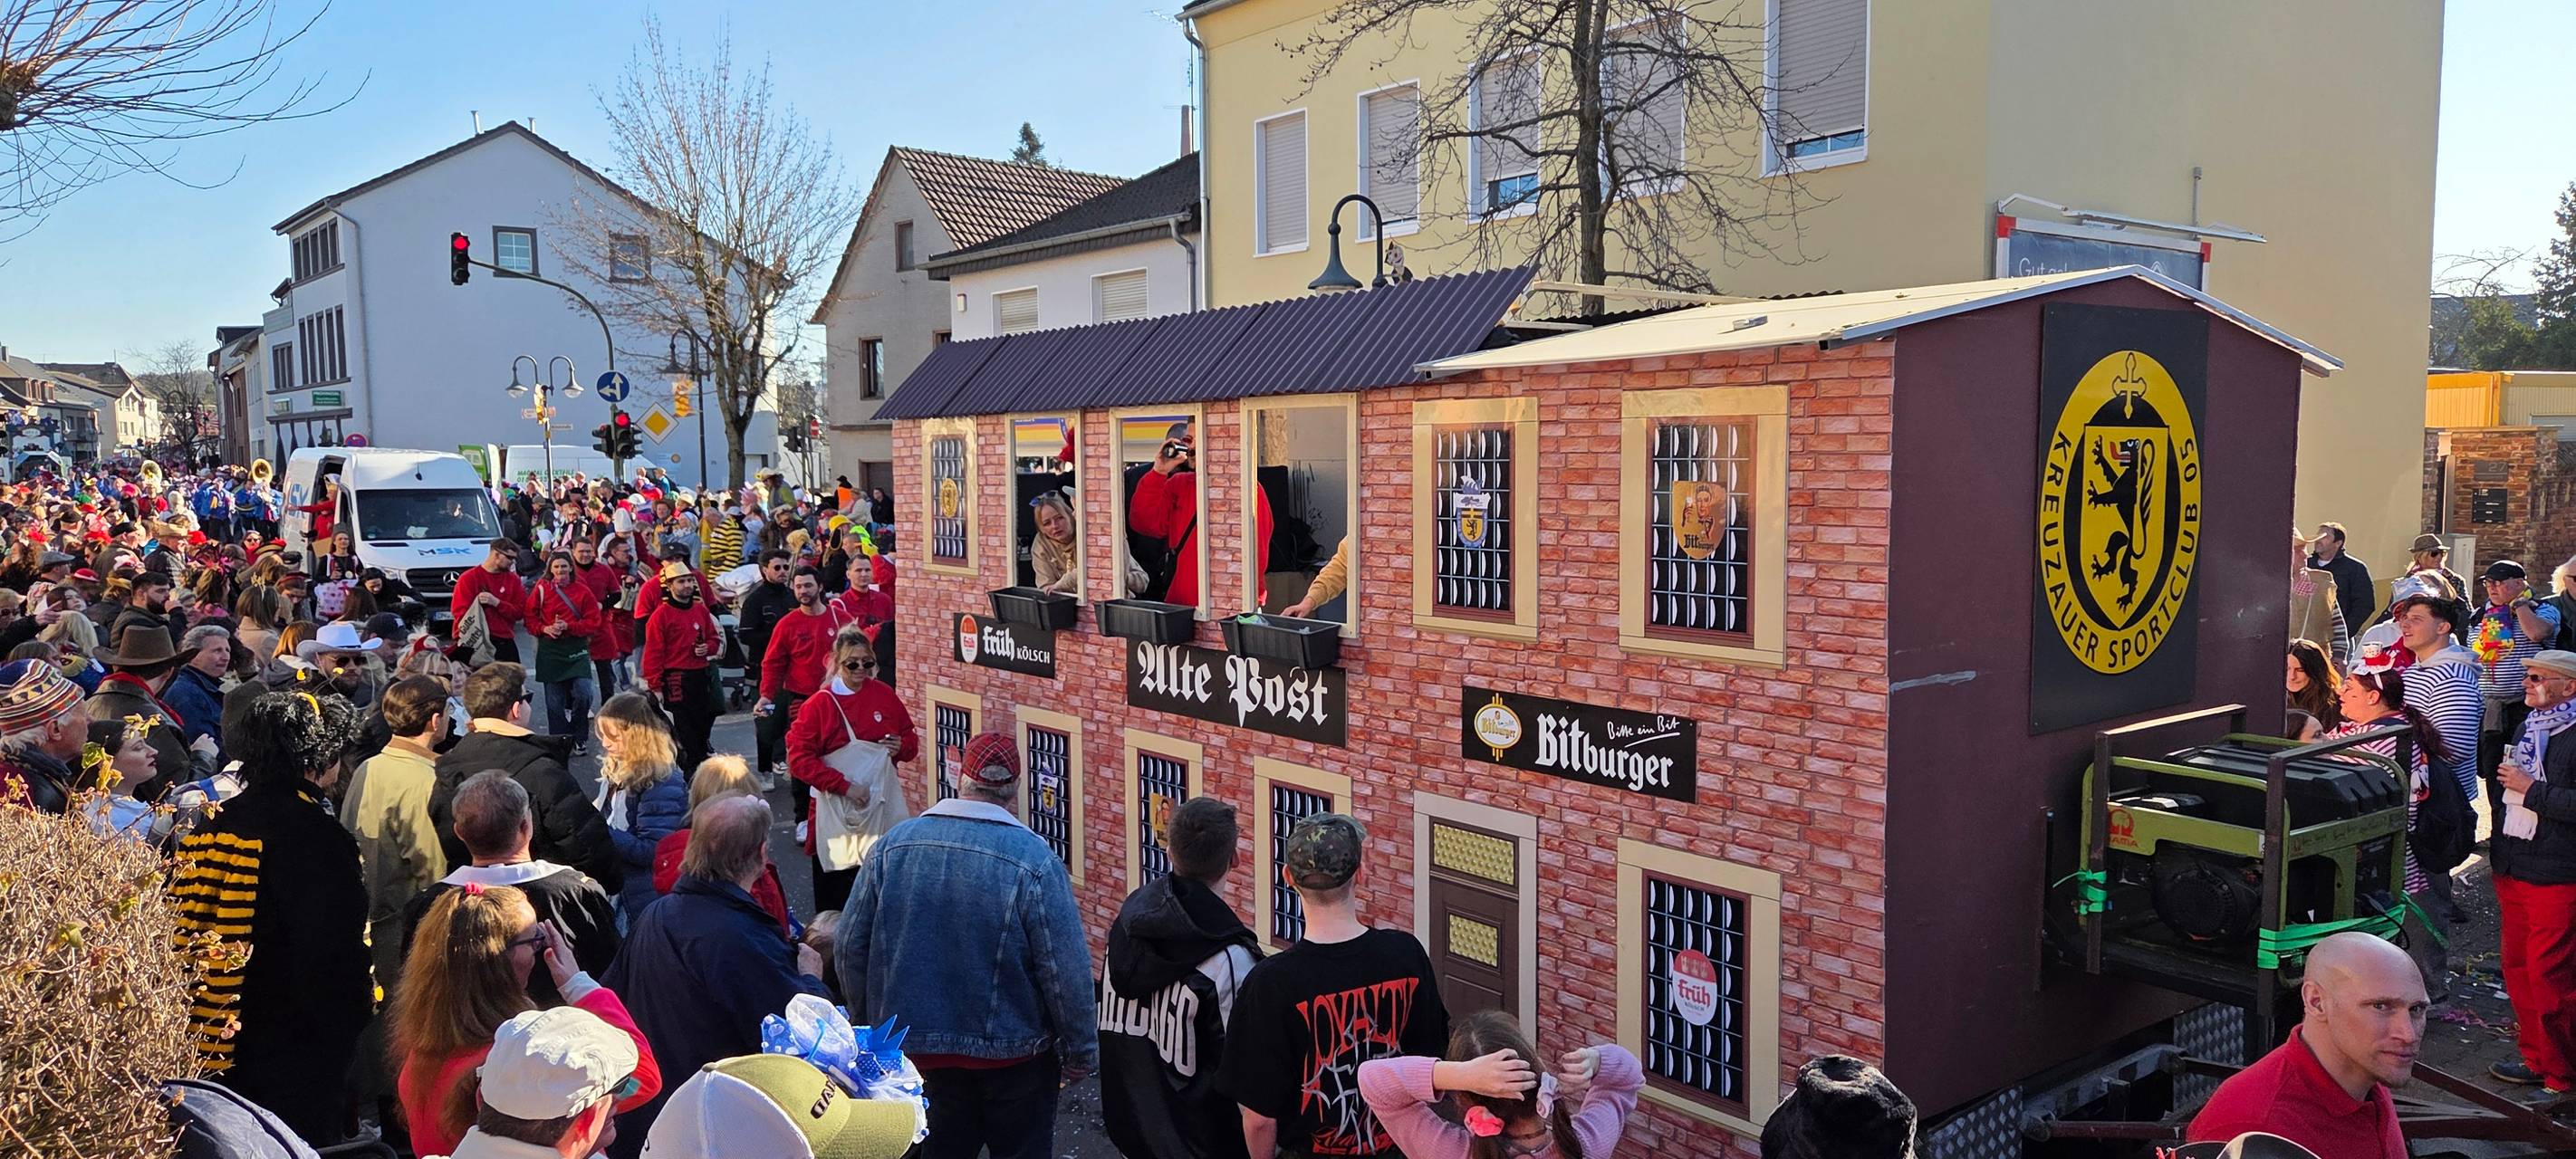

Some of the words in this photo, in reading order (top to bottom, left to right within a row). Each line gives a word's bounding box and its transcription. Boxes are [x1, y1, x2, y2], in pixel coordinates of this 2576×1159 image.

[2487, 462, 2507, 472] 27
[417, 547, 472, 556] MSK
[2042, 430, 2099, 664] KREUZAUER
[2108, 502, 2198, 668] SPORTCLUB
[2179, 438, 2198, 482] 05
[982, 625, 1015, 662] früh
[1016, 646, 1051, 665] KÖLSCH
[1137, 640, 1213, 704] Alte
[1225, 654, 1329, 727] Post
[1534, 712, 1675, 793] Bitburger
[1606, 721, 1635, 741] Bitte
[1637, 724, 1656, 736] ein
[1656, 714, 1681, 733] Bit
[1096, 956, 1199, 1078] HICAGO
[1677, 979, 1712, 1009] früh
[1295, 977, 1420, 1124] LOYALTY
